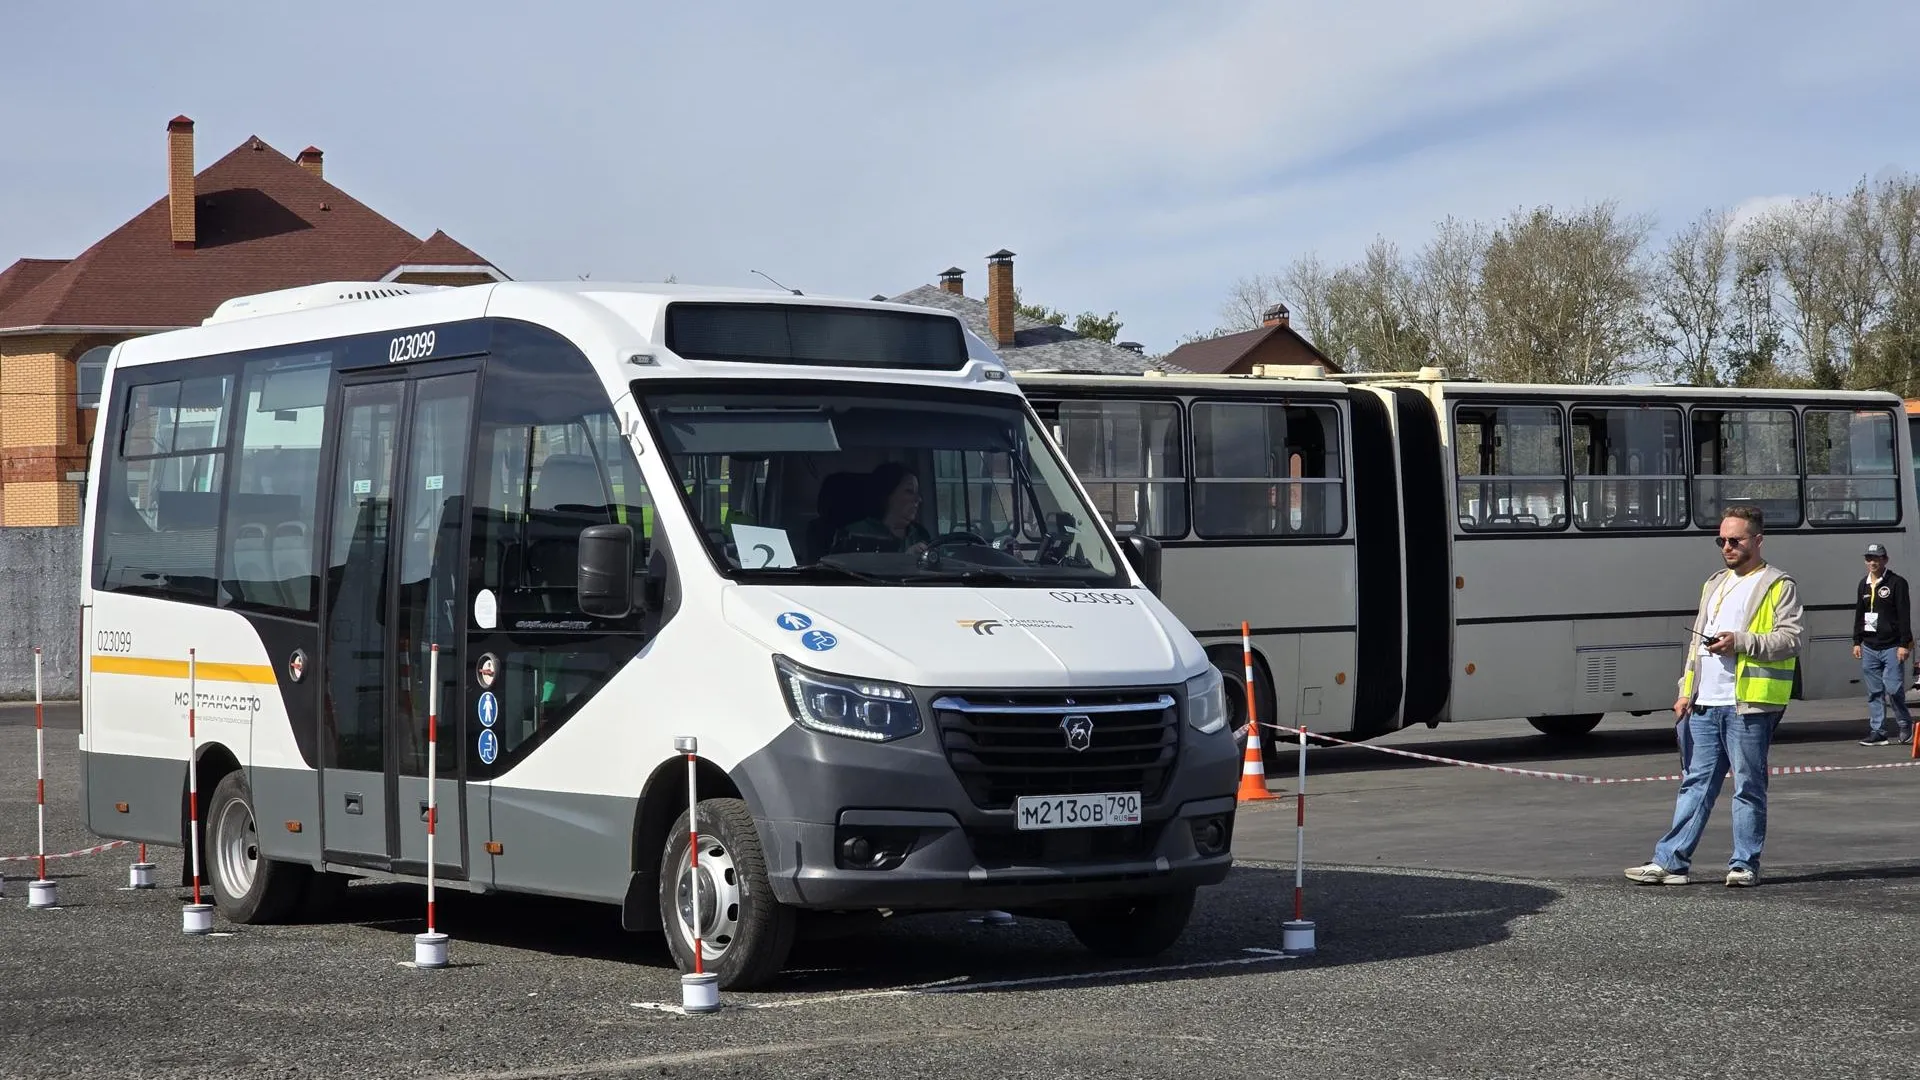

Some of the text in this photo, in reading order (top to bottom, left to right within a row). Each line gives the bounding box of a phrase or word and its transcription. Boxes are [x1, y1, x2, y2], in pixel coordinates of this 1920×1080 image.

[388, 330, 436, 363] 023099
[752, 543, 780, 570] 2
[1048, 591, 1135, 606] 023099
[97, 630, 132, 653] 023099
[174, 691, 261, 712] МОТРАНСАВТО
[1107, 796, 1136, 815] 790
[1113, 814, 1128, 822] RUS
